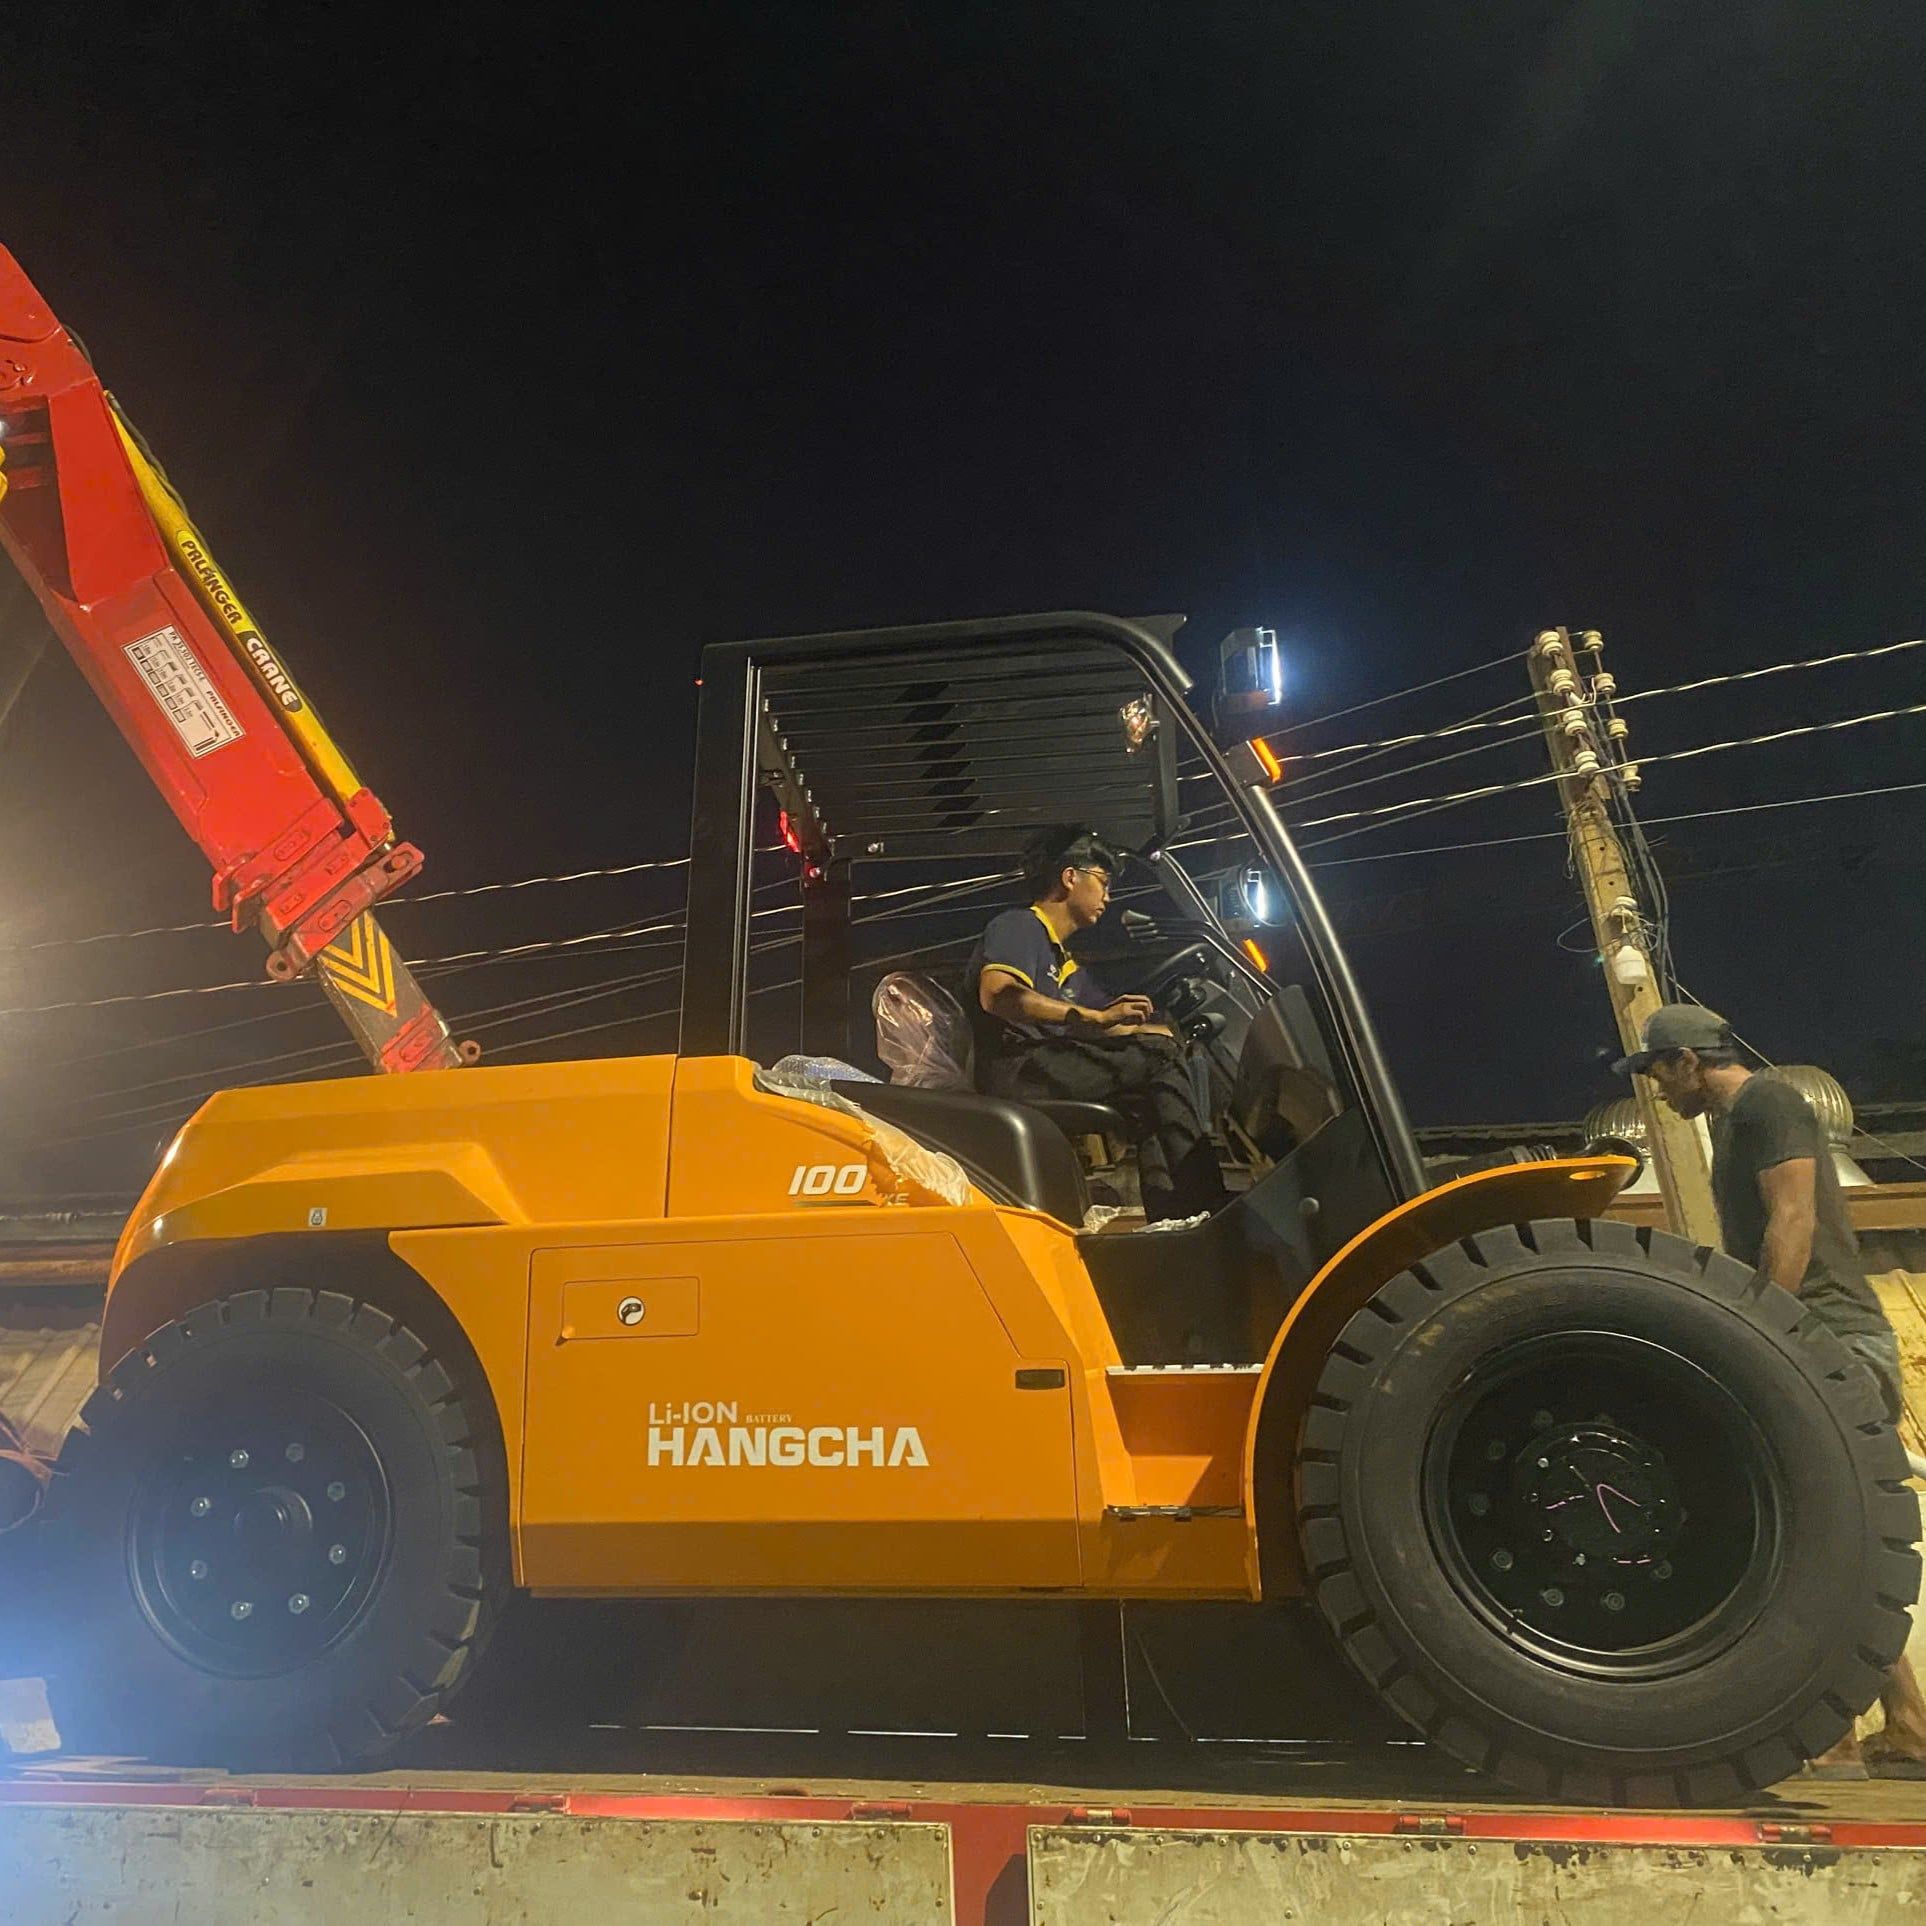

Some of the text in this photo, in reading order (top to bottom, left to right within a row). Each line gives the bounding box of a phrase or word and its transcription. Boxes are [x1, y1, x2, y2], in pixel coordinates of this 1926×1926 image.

[182, 540, 298, 706] PALFINGER CRANE
[206, 690, 241, 737] PALFINGER
[787, 1164, 867, 1195] 100
[649, 1401, 792, 1424] Li-ION BATTERY
[647, 1426, 930, 1467] HANGCHA
